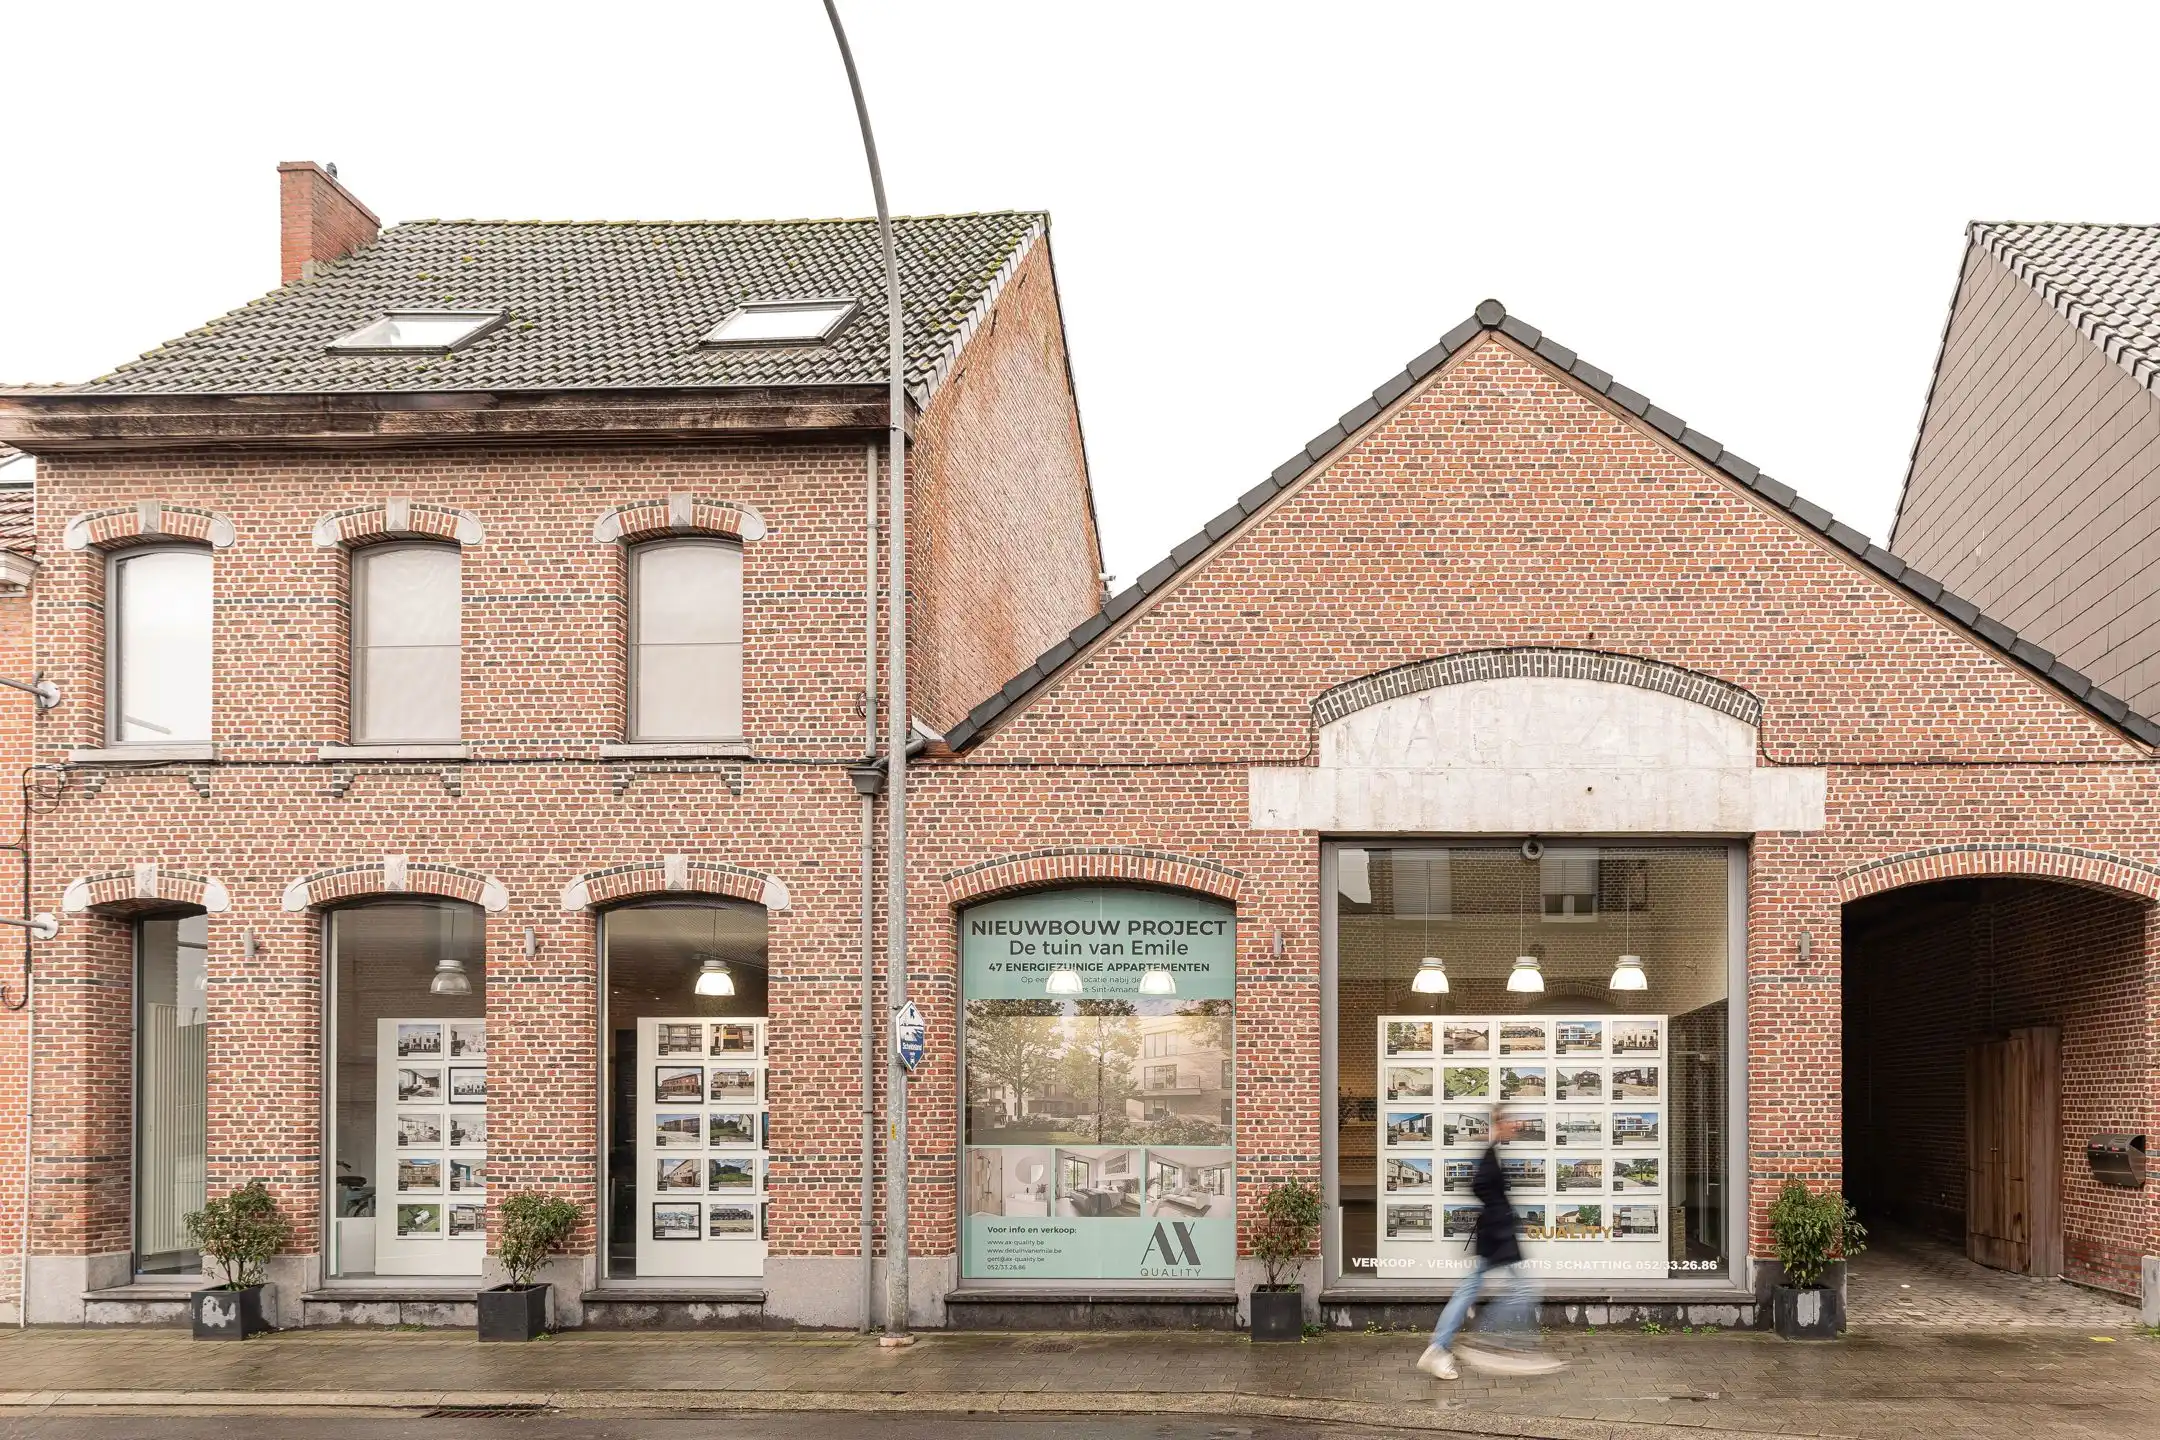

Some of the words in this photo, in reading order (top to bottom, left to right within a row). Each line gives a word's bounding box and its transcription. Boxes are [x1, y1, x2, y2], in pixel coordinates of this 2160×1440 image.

[971, 919, 1121, 936] NIEUWBOUW
[1127, 919, 1227, 936] PROJECT
[1009, 940, 1036, 955] De
[1042, 939, 1082, 955] tuin
[1088, 943, 1124, 955] van
[1131, 939, 1189, 955] Emile
[988, 962, 1003, 972] 47
[1106, 962, 1210, 972] APPARTEMENTEN
[1021, 976, 1033, 984] Op
[1109, 976, 1129, 984] nabij
[1040, 1226, 1077, 1235] verkoop:
[1526, 1225, 1613, 1240] QUALITY
[1140, 1221, 1202, 1266] AX
[1351, 1257, 1416, 1268] VERKOOP
[1556, 1260, 1632, 1270] SCHATTING
[1636, 1260, 1718, 1270] 052/33.26.86
[1140, 1267, 1202, 1277] QUALITY
